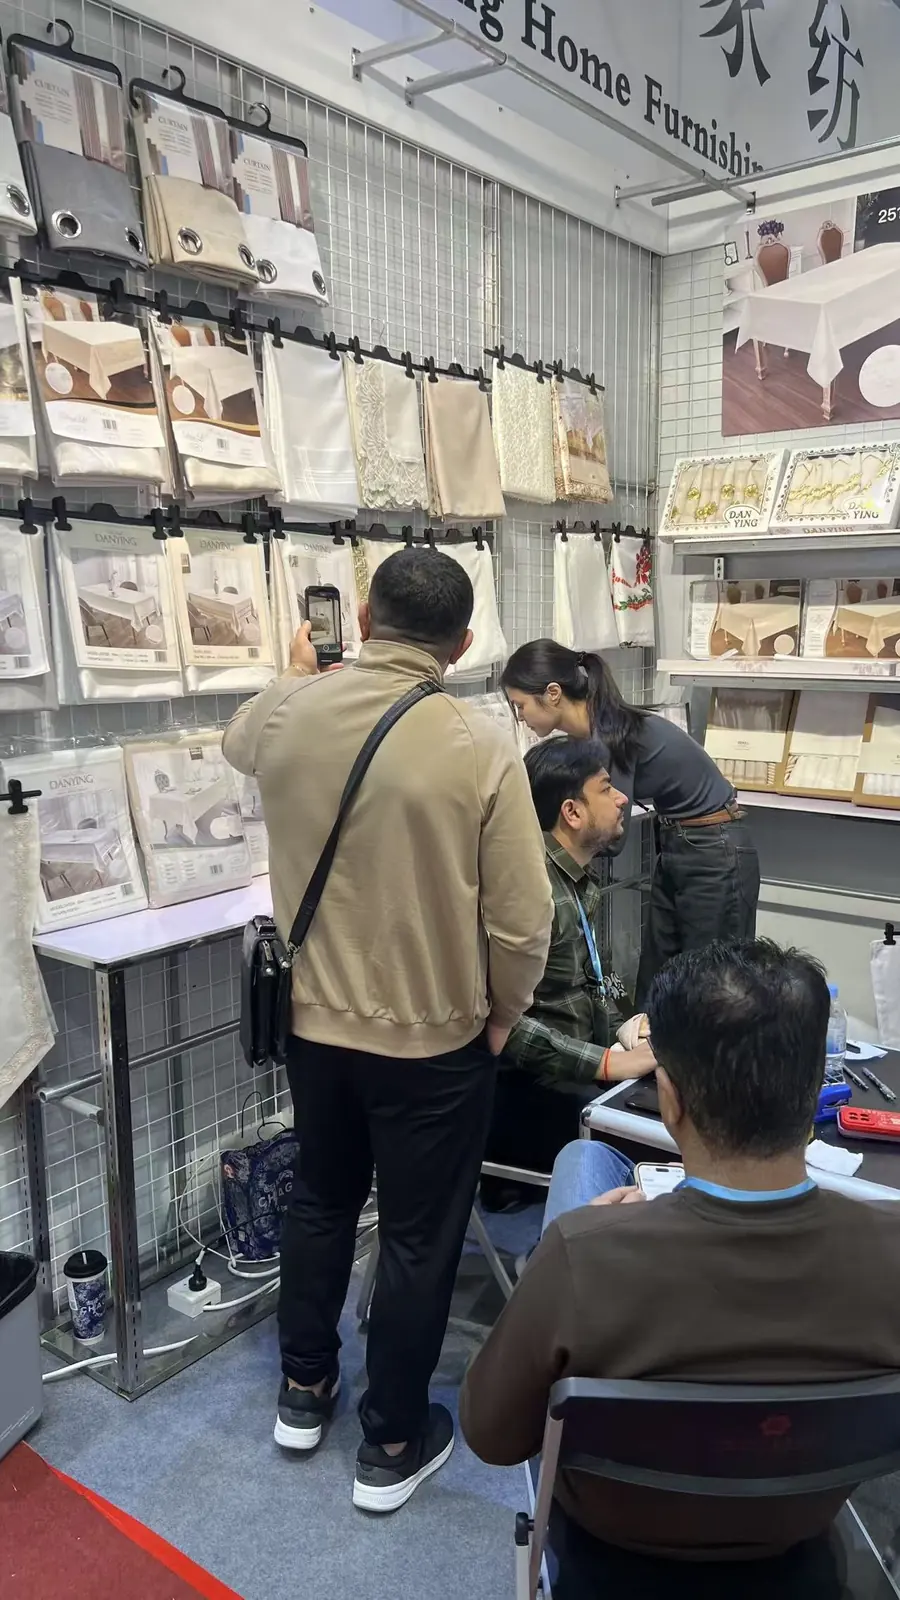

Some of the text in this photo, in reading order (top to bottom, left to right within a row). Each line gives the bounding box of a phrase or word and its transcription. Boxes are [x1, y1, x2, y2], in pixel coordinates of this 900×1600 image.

[520, 0, 632, 106] Home
[158, 116, 188, 132] CURTAIN
[243, 159, 271, 171] CURTAIN
[729, 510, 752, 519] DAN
[853, 510, 879, 519] YING
[734, 519, 758, 528] YING
[802, 526, 852, 535] DANYING
[95, 533, 137, 546] DANYING
[49, 774, 94, 790] DANYING
